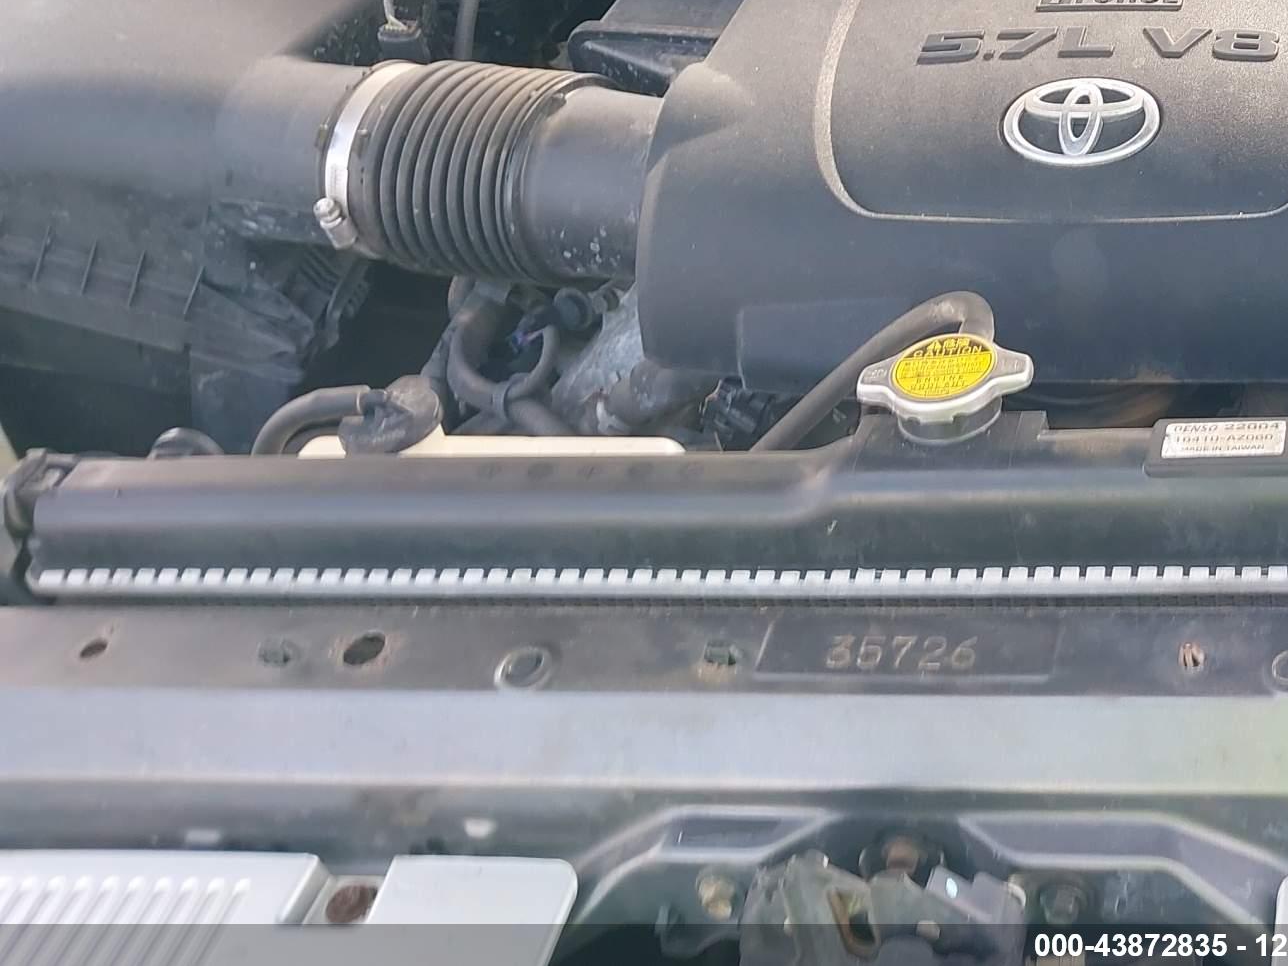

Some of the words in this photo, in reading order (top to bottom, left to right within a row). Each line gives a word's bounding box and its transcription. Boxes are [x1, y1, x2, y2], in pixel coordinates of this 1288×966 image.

[916, 25, 1115, 65] 5.7L
[1142, 27, 1281, 62] V8
[914, 345, 982, 359] CAUTION
[1173, 425, 1218, 433] DENSO
